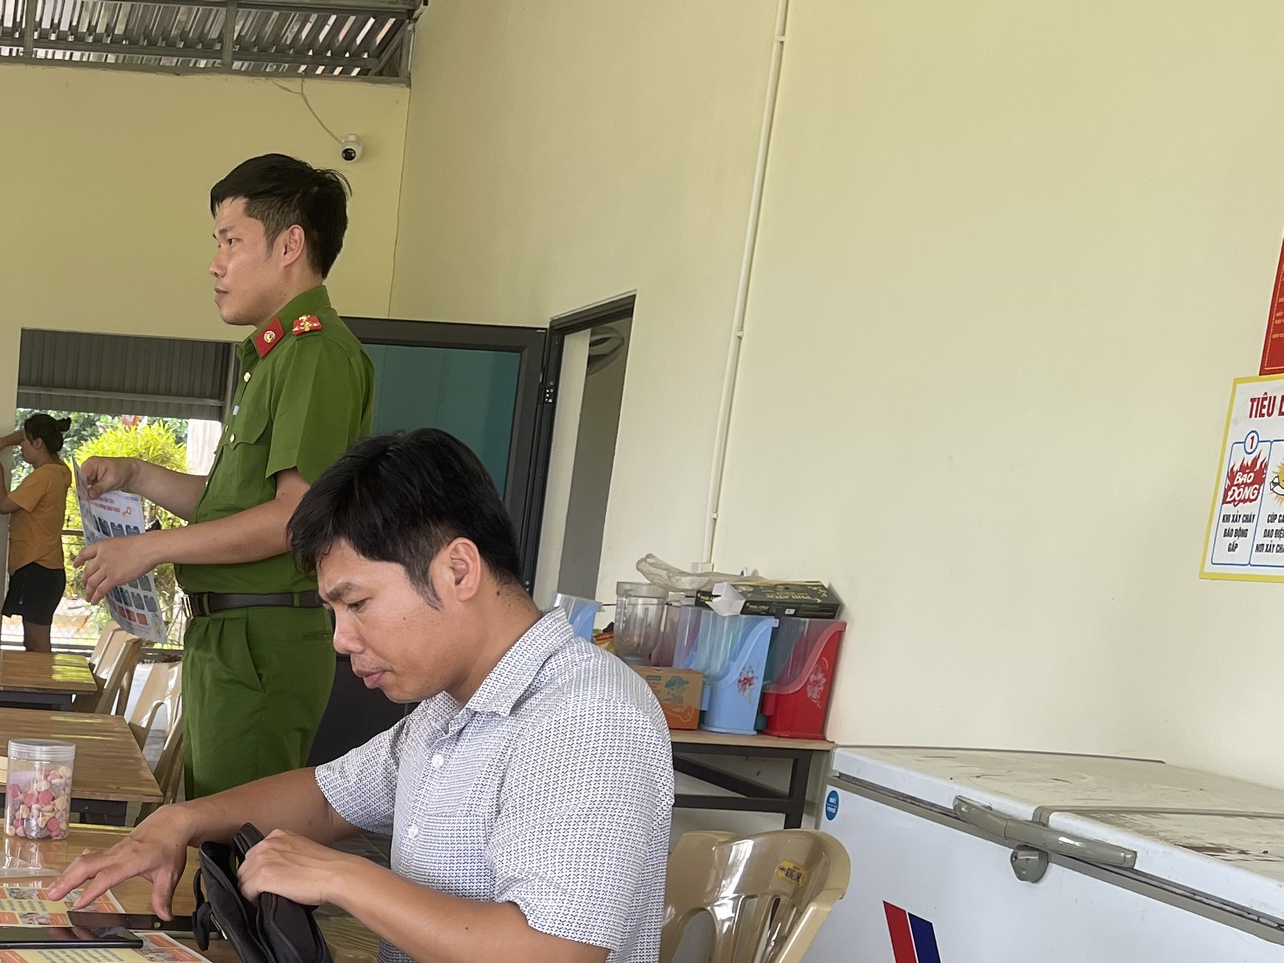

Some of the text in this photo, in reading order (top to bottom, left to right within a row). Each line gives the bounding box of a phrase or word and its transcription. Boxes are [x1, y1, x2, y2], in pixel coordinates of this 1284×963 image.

[1249, 391, 1277, 418] TIÊU
[1249, 435, 1255, 450] 1
[1234, 470, 1255, 485] BÁO
[1226, 485, 1260, 506] ĐỘNG
